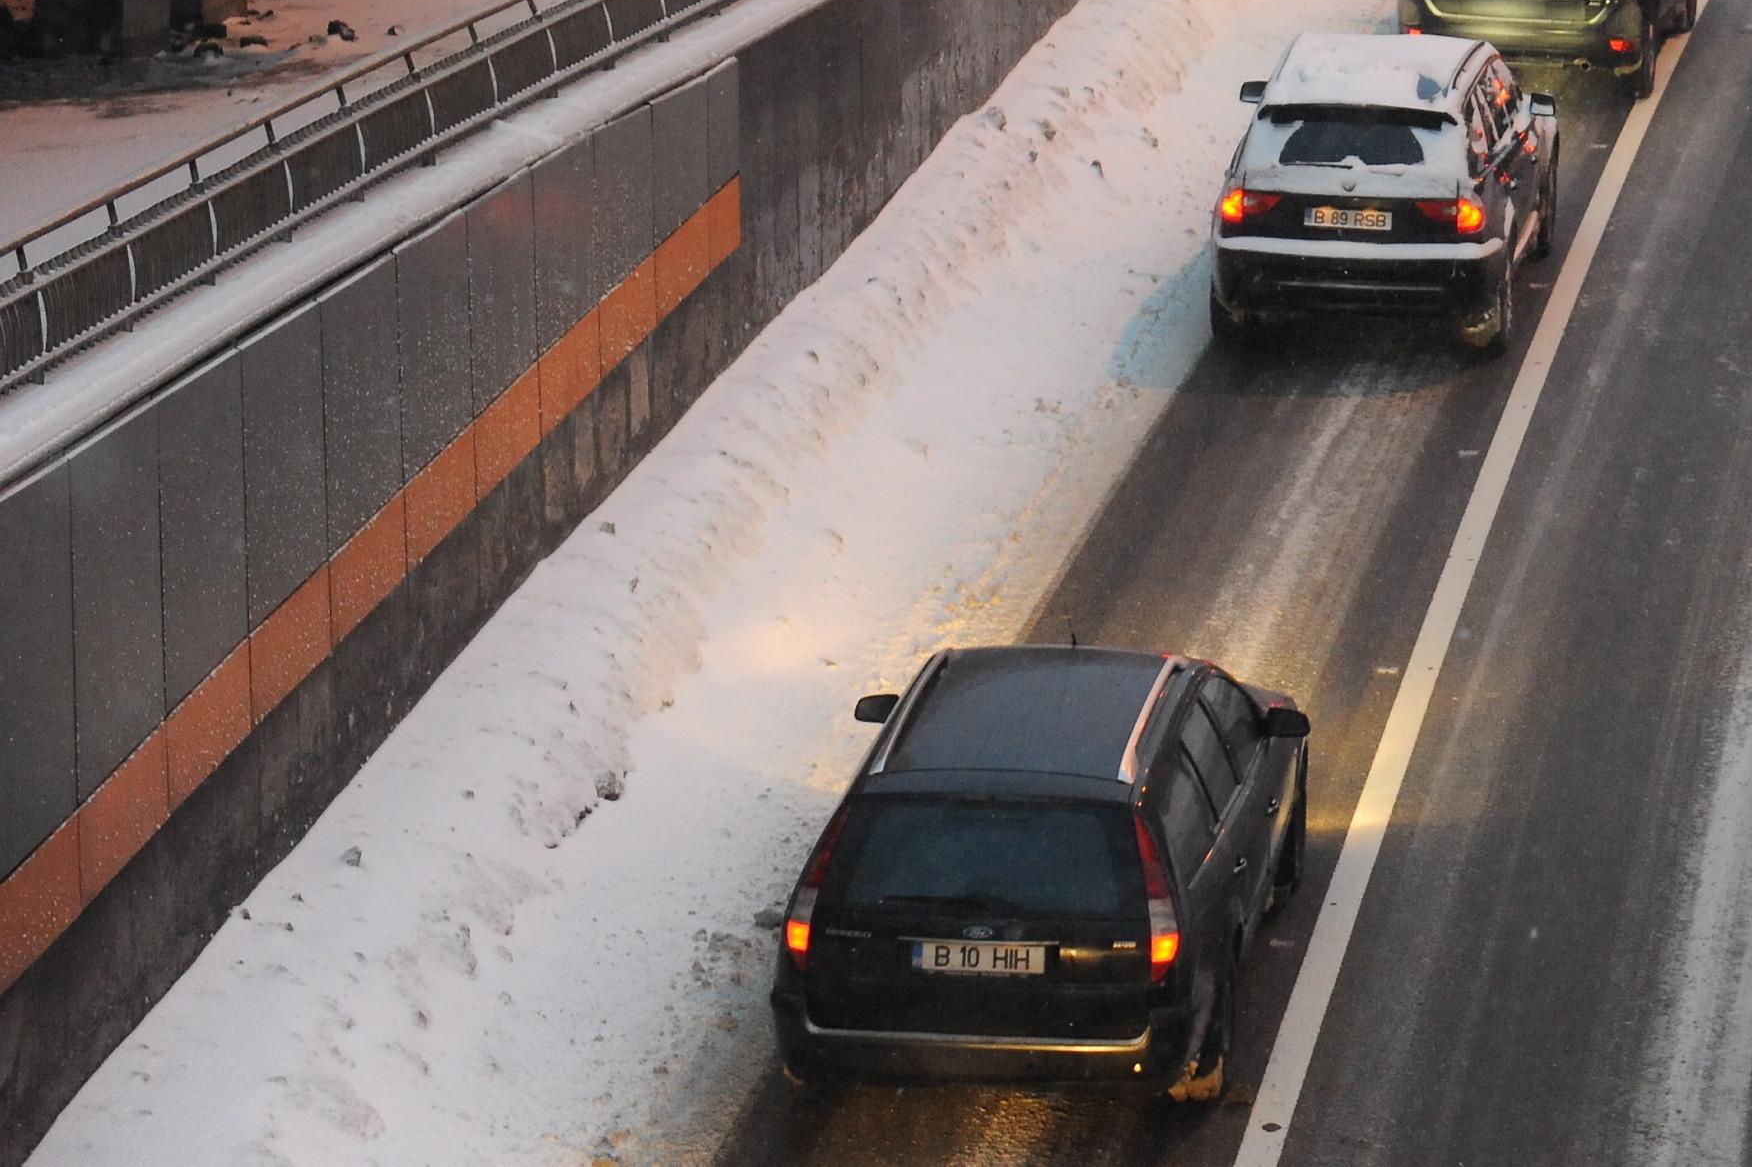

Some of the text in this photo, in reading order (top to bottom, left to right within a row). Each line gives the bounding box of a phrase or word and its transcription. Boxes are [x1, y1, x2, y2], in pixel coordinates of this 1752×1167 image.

[1314, 210, 1387, 227] B 89 RSB
[934, 945, 1030, 970] B 10 HIH
